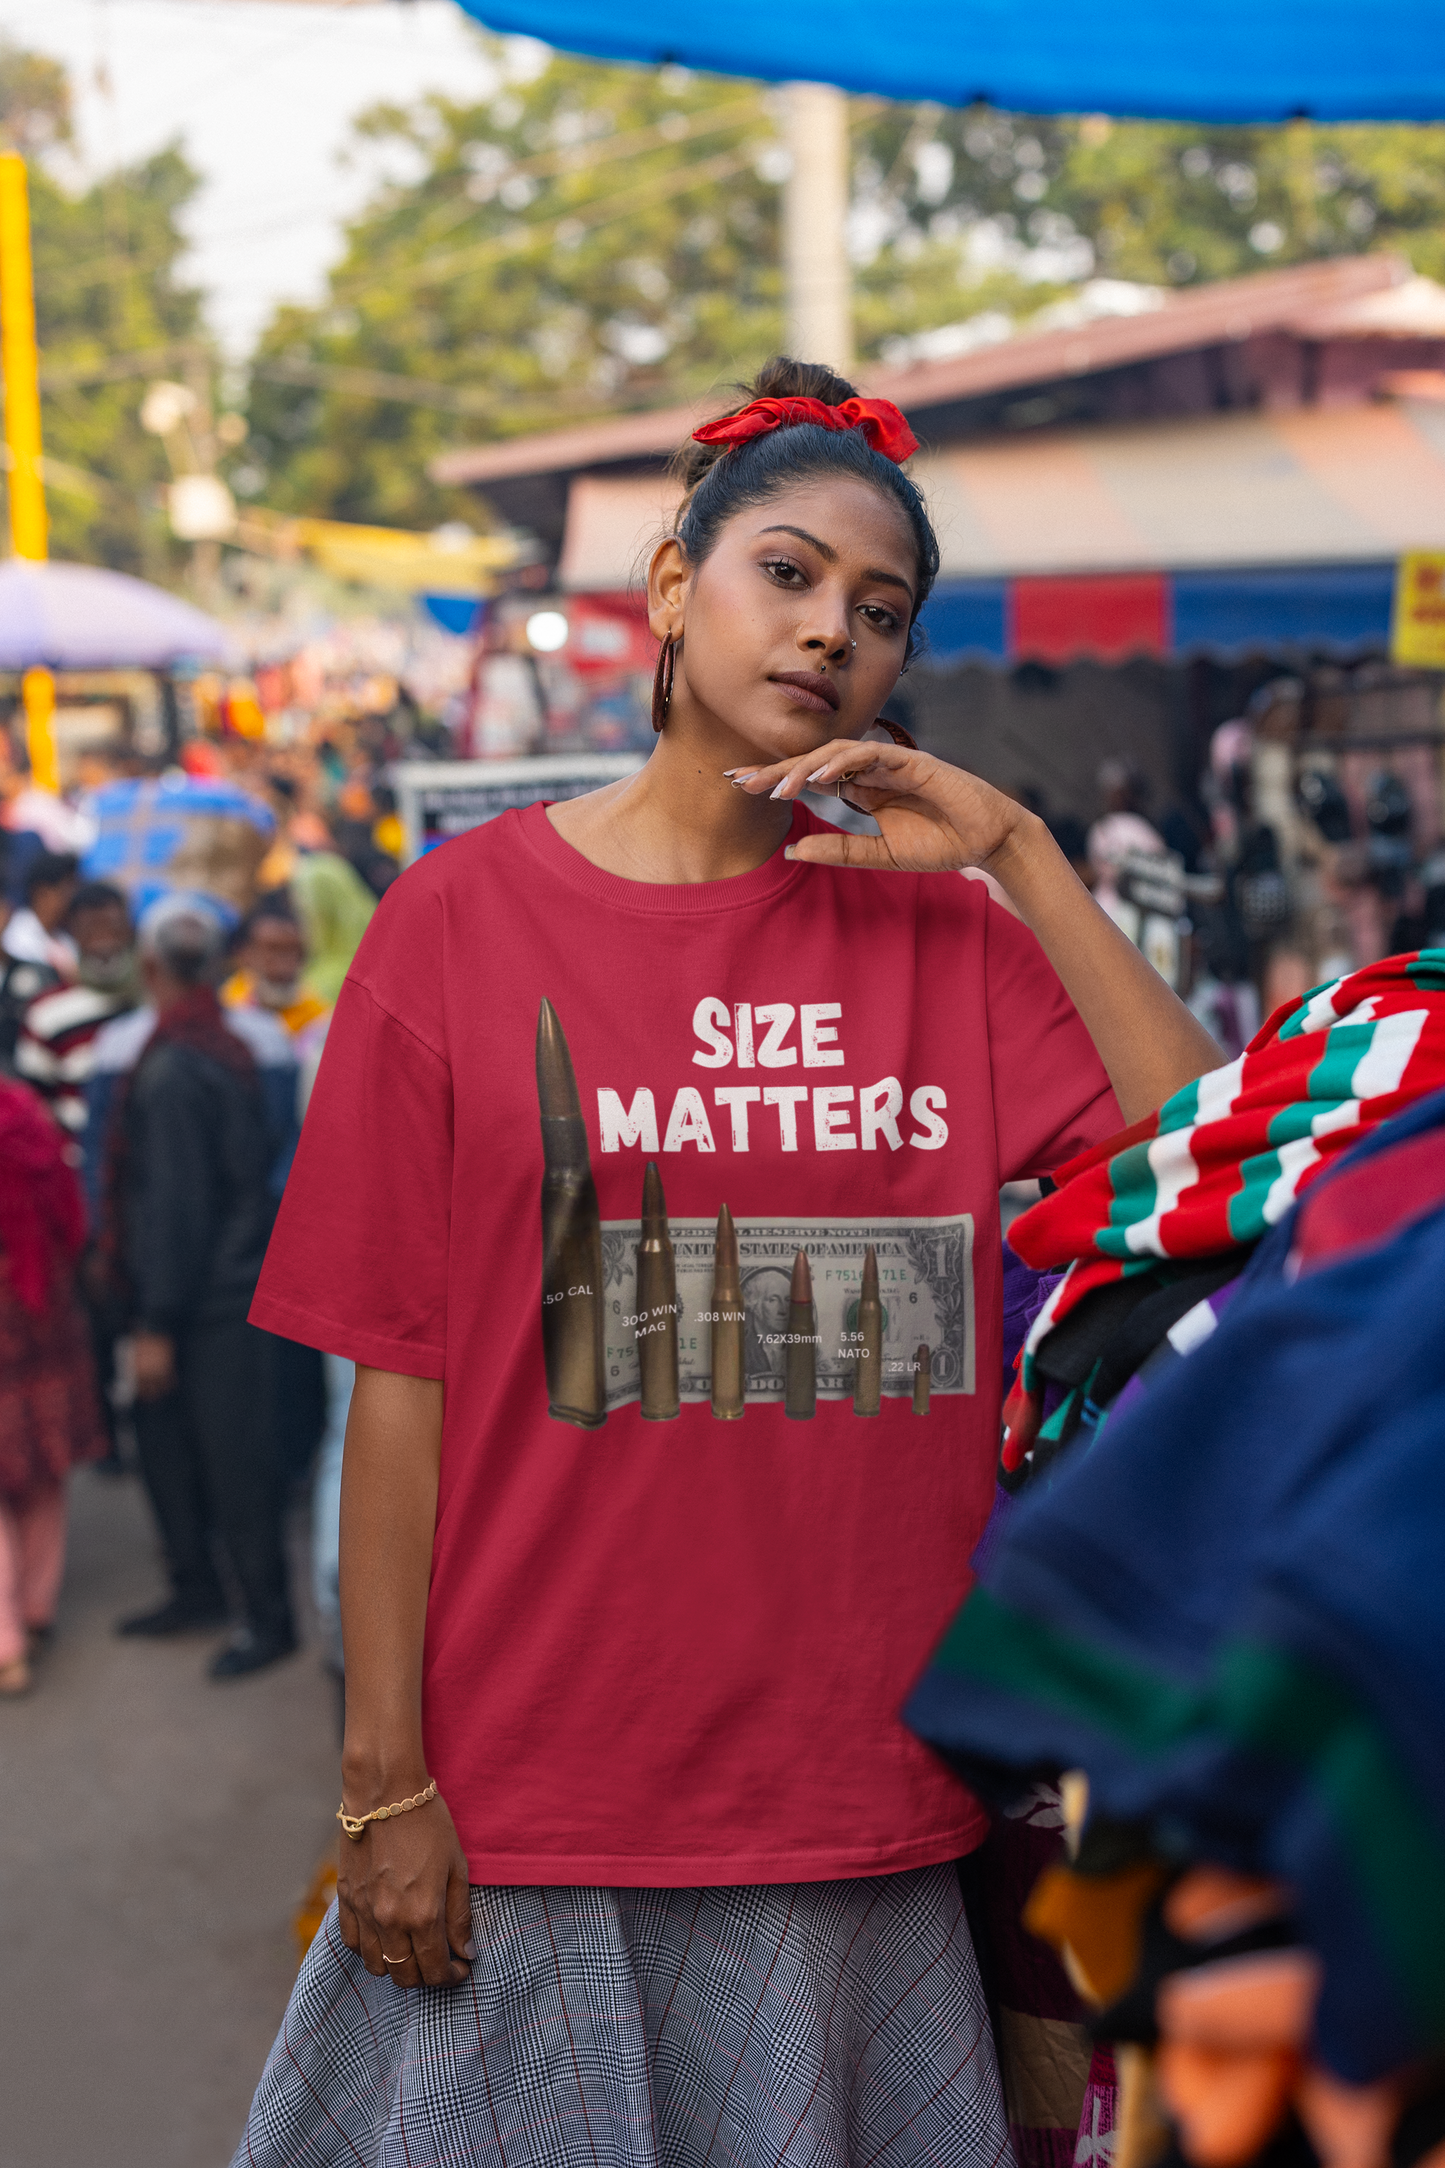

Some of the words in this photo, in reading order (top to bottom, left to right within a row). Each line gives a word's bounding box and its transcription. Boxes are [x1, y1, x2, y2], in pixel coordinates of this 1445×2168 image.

[692, 996, 845, 1068] SIZE
[597, 1076, 949, 1152] MATTERS
[669, 1228, 747, 1237] FEDEL
[827, 1228, 868, 1237] NOTE
[739, 1242, 801, 1256] STATES
[804, 1242, 826, 1256] OF
[935, 1242, 948, 1278] 1
[543, 1291, 564, 1305] .50
[568, 1285, 593, 1296] CAL
[908, 1292, 918, 1304] 6
[622, 1311, 649, 1327] 300
[652, 1304, 677, 1317] WIN
[694, 1311, 720, 1322] .308
[722, 1311, 746, 1322] WIN
[634, 1321, 666, 1339] MAG
[756, 1333, 823, 1344] 7.62X39mm
[840, 1331, 865, 1342] 5.56
[838, 1348, 870, 1359] NATO
[610, 1365, 620, 1377] 6
[888, 1362, 904, 1372] .22
[906, 1362, 921, 1372] LR
